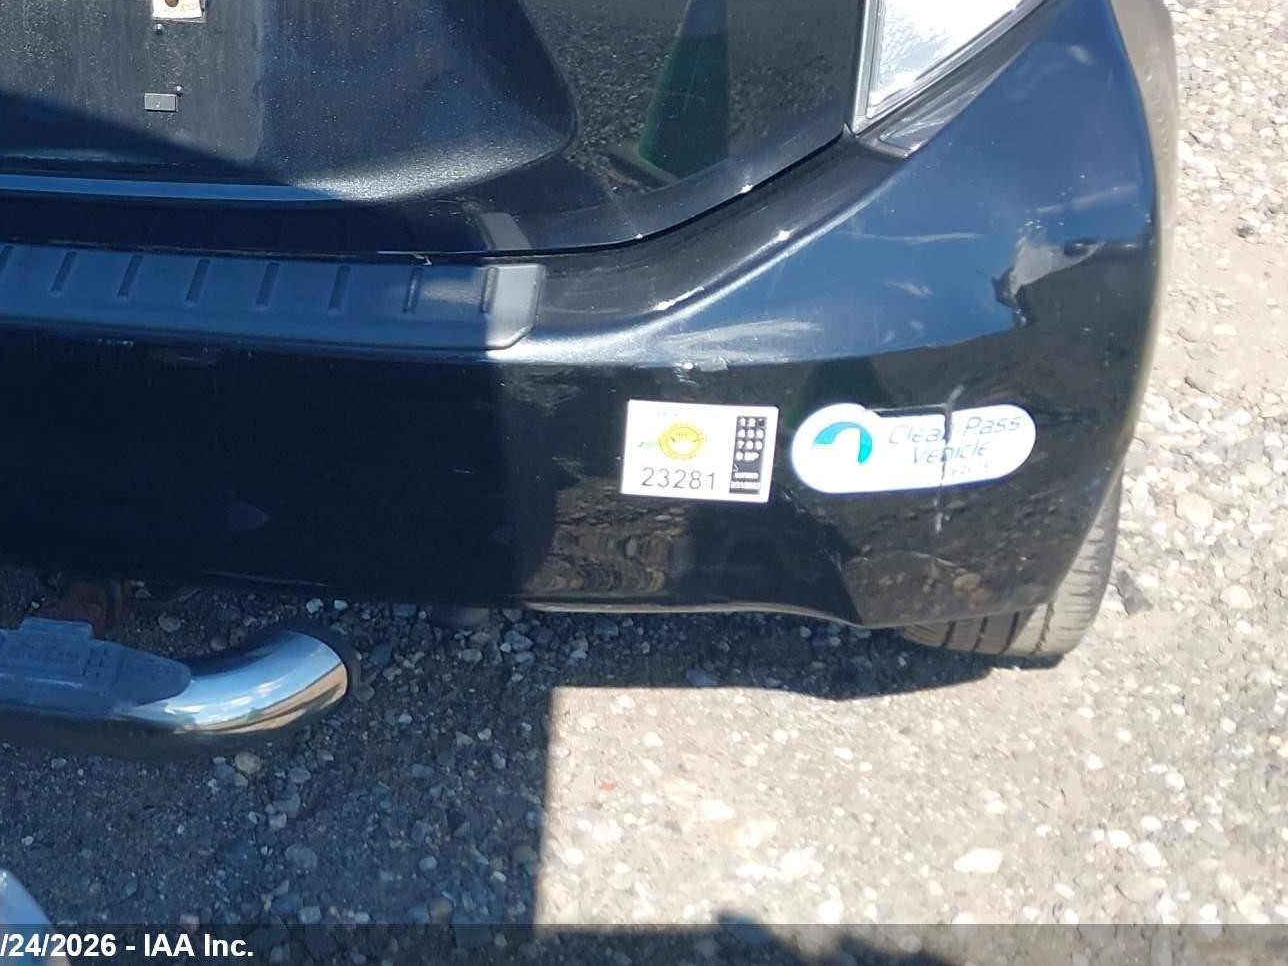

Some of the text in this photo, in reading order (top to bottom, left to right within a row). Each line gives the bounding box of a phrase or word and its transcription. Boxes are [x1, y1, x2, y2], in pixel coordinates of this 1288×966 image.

[888, 416, 1022, 444] Clea Pass
[641, 466, 716, 490] 23281
